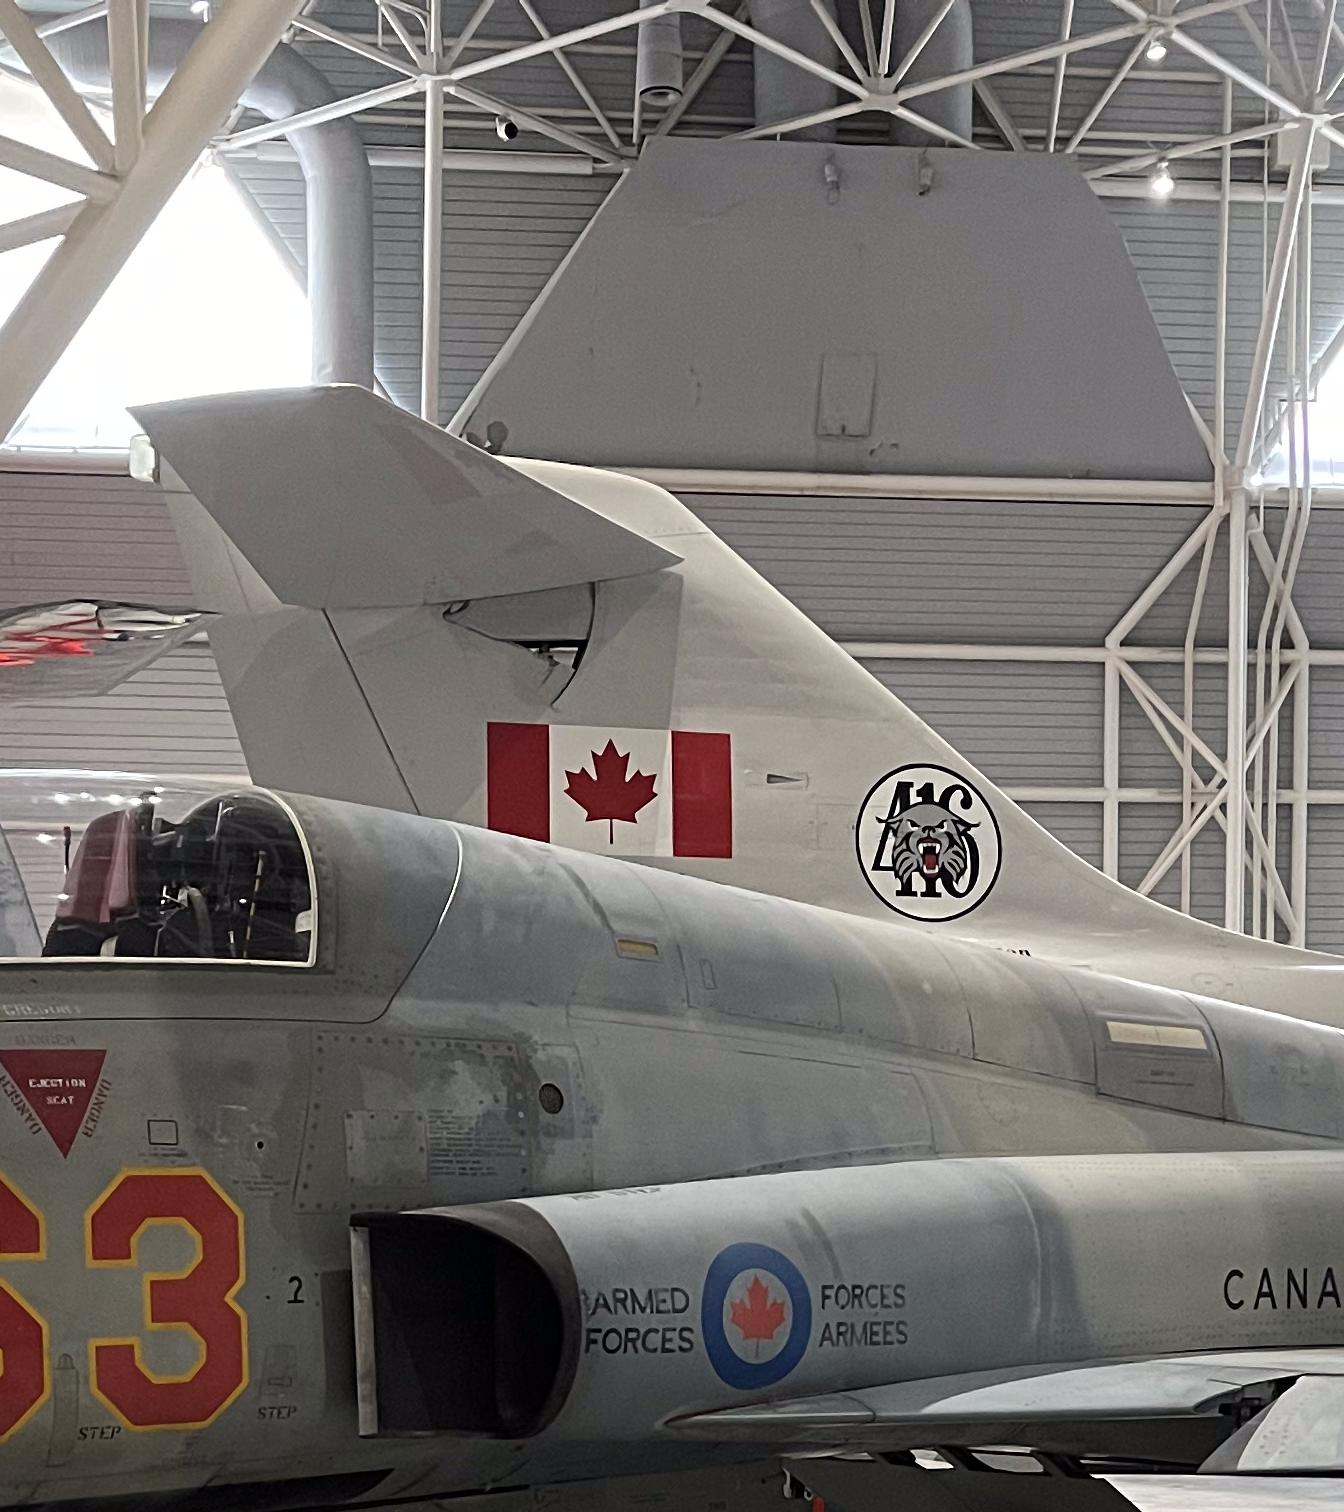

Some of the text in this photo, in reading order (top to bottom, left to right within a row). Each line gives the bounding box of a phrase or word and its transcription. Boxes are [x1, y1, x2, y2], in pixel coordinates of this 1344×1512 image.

[871, 781, 981, 898] 416
[28, 1078, 87, 1089] EJECTION
[81, 1077, 114, 1139] DANGER
[286, 1276, 305, 1305] 2
[588, 1286, 690, 1317] ARMED
[820, 1283, 907, 1311] FORCES
[584, 1326, 695, 1356] FORCES
[256, 1405, 298, 1421] STEP
[77, 1425, 122, 1442] STEP
